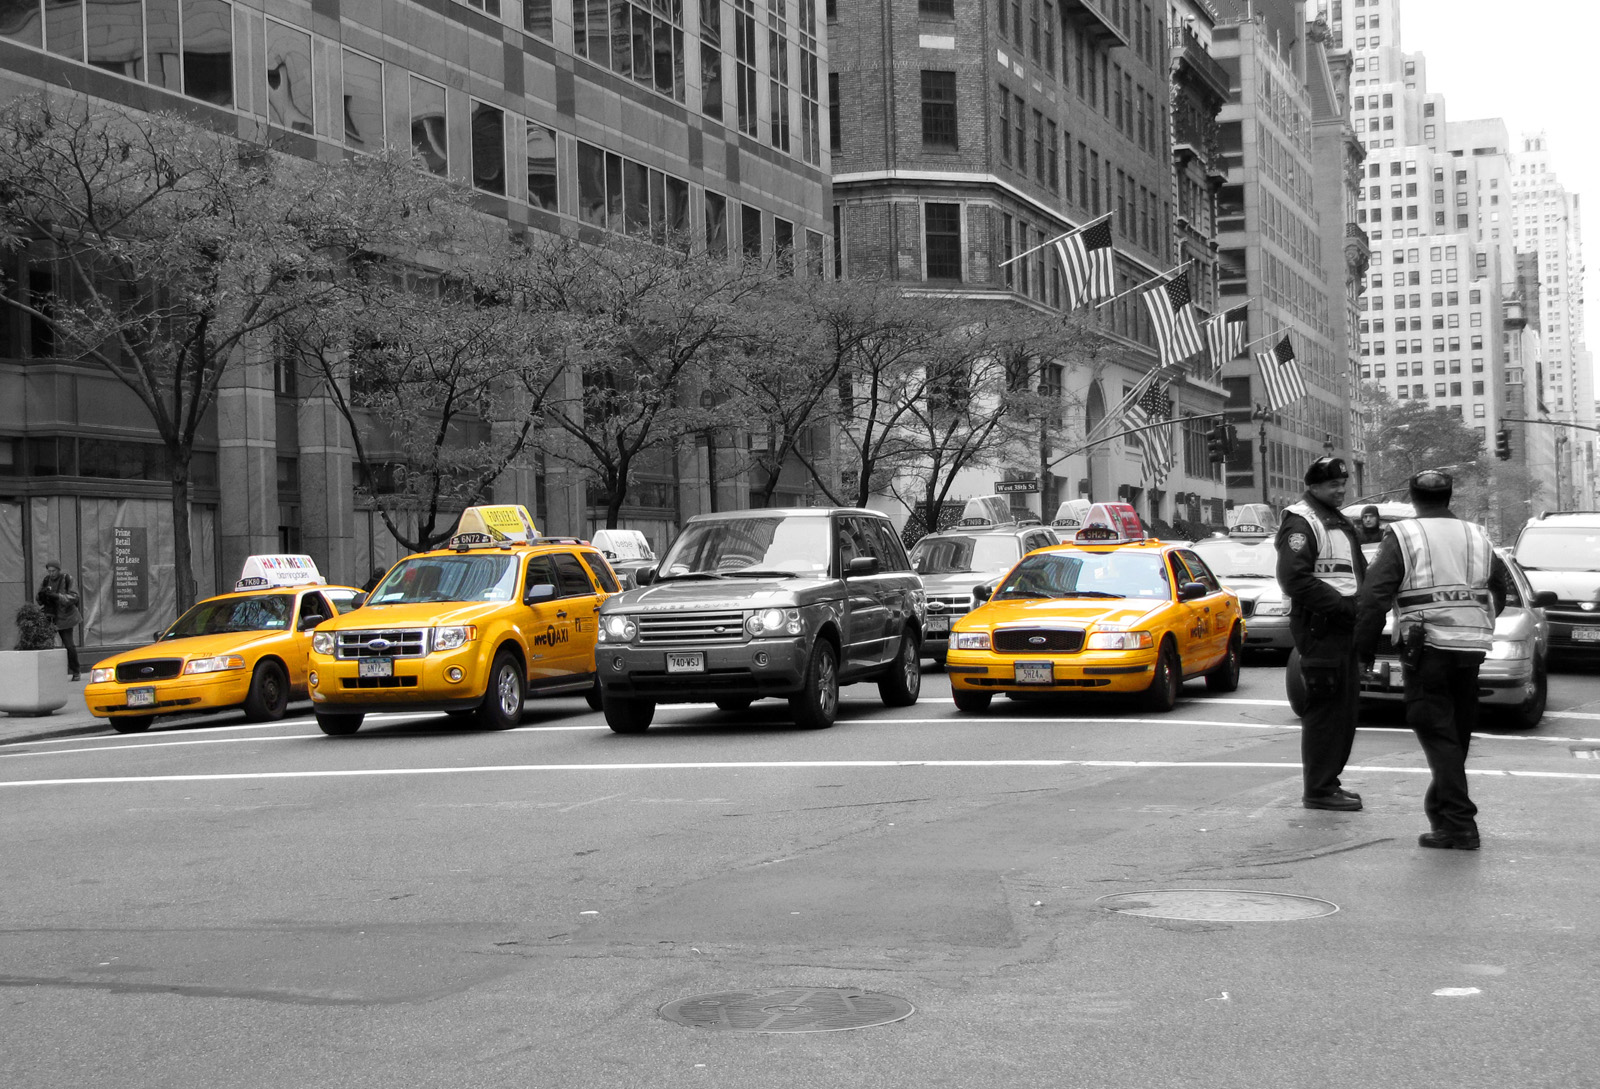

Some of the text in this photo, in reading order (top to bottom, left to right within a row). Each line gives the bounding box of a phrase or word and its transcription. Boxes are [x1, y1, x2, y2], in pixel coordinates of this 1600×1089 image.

[487, 511, 510, 522] FOREVER
[115, 529, 131, 537] Prime
[1087, 531, 1107, 539] 5H24
[115, 538, 131, 546] Retail
[461, 535, 480, 543] 6N72
[615, 540, 633, 548] bebe
[115, 547, 131, 556] Space
[115, 556, 140, 564] For Lease
[260, 557, 314, 569] HAPPY MERRY
[534, 633, 548, 646] NYC
[547, 625, 569, 647] TAXI
